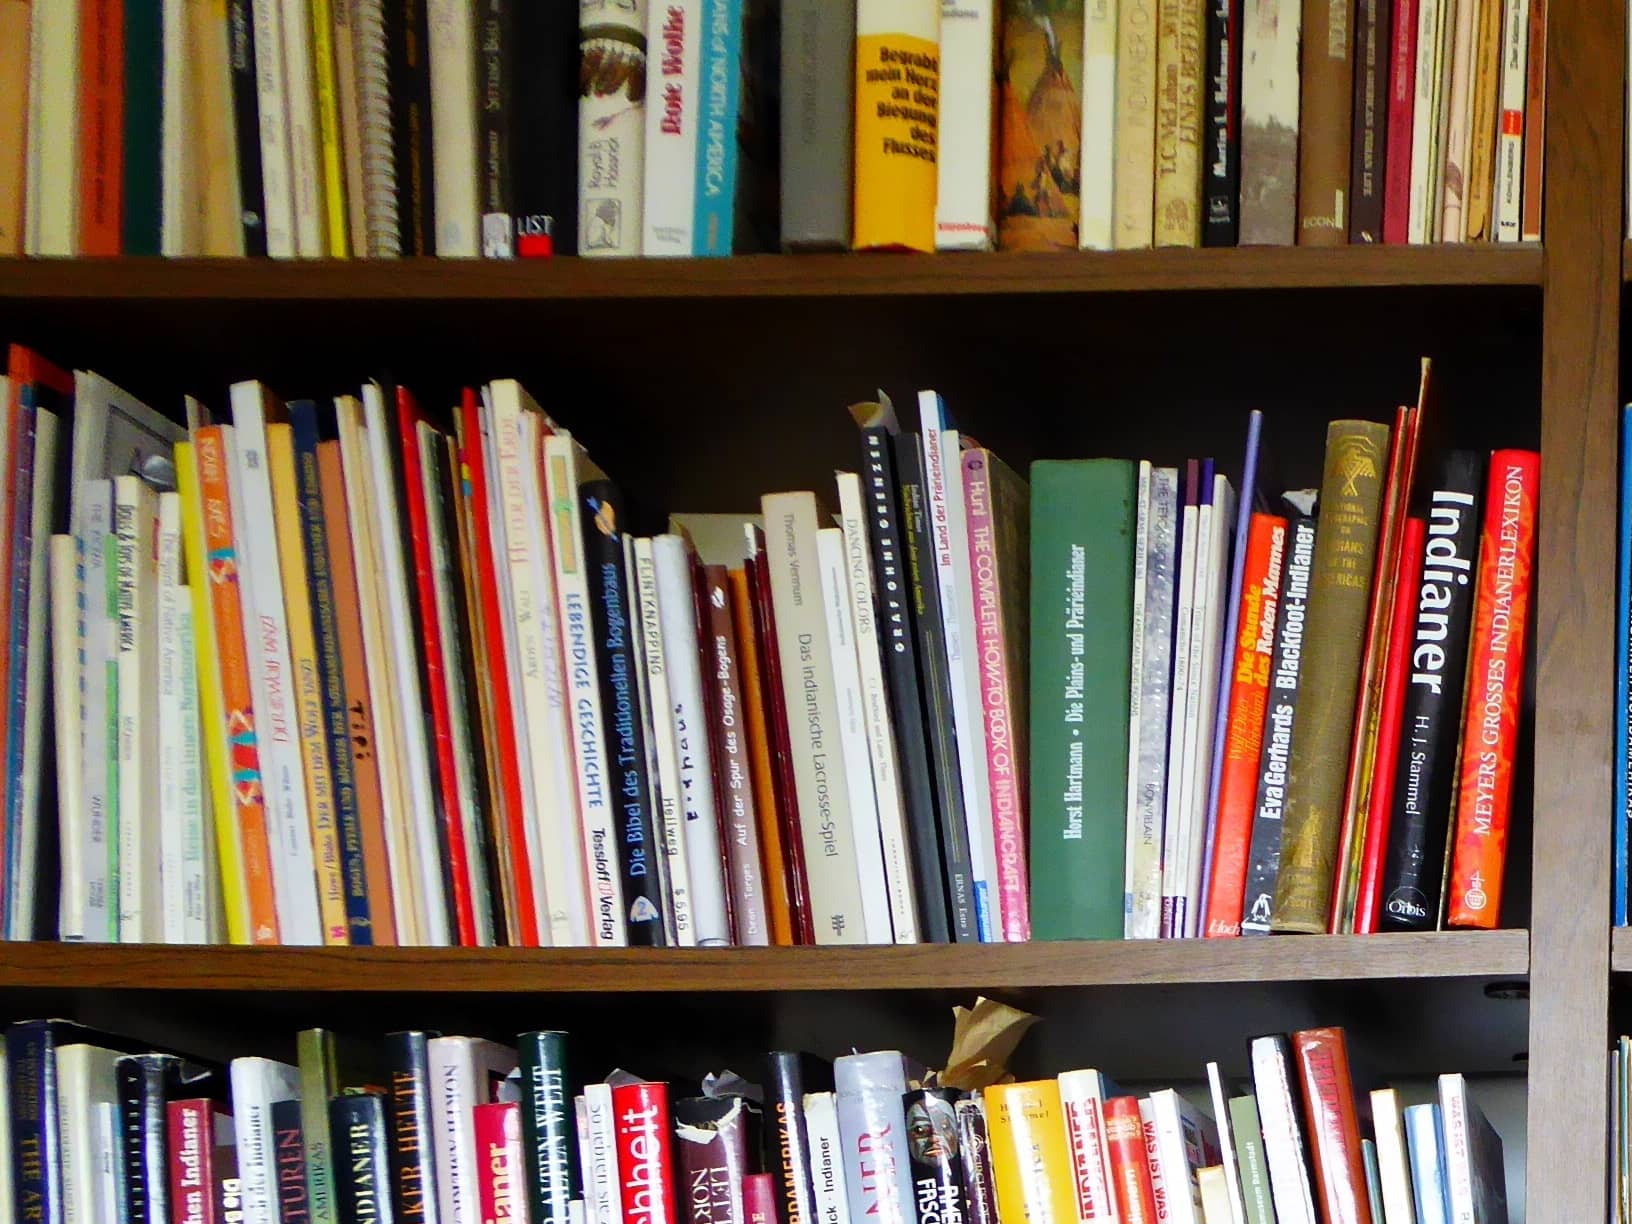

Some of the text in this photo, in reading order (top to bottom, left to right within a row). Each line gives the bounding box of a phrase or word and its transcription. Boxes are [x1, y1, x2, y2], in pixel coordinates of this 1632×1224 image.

[784, 513, 796, 559] Thomas
[926, 427, 951, 567] Im Land der Prärieindianer
[639, 557, 663, 675] FLINTKNAPPING
[1066, 544, 1085, 630] Prärieindianer
[1276, 524, 1315, 690] Blackfoot-Indianer
[1412, 490, 1473, 694] Indianer
[1473, 465, 1522, 836] MEYERS GROSSES INDIANERLEXIKON
[567, 592, 603, 808] LEBENDIGE GESCHICHTE
[601, 562, 647, 877] Die Bibel des Traditionellen Bogenbaus
[714, 635, 748, 847] Auf der Spur des Osage-Bogens
[798, 632, 838, 858] Das indianische Lacrosse-Spiel
[1066, 702, 1084, 723] Die
[1260, 704, 1293, 820] Eva Gerhards
[1063, 742, 1084, 839] Horst Hartmann
[178, 1108, 200, 1188] Indianer
[817, 1136, 834, 1194] Indianer
